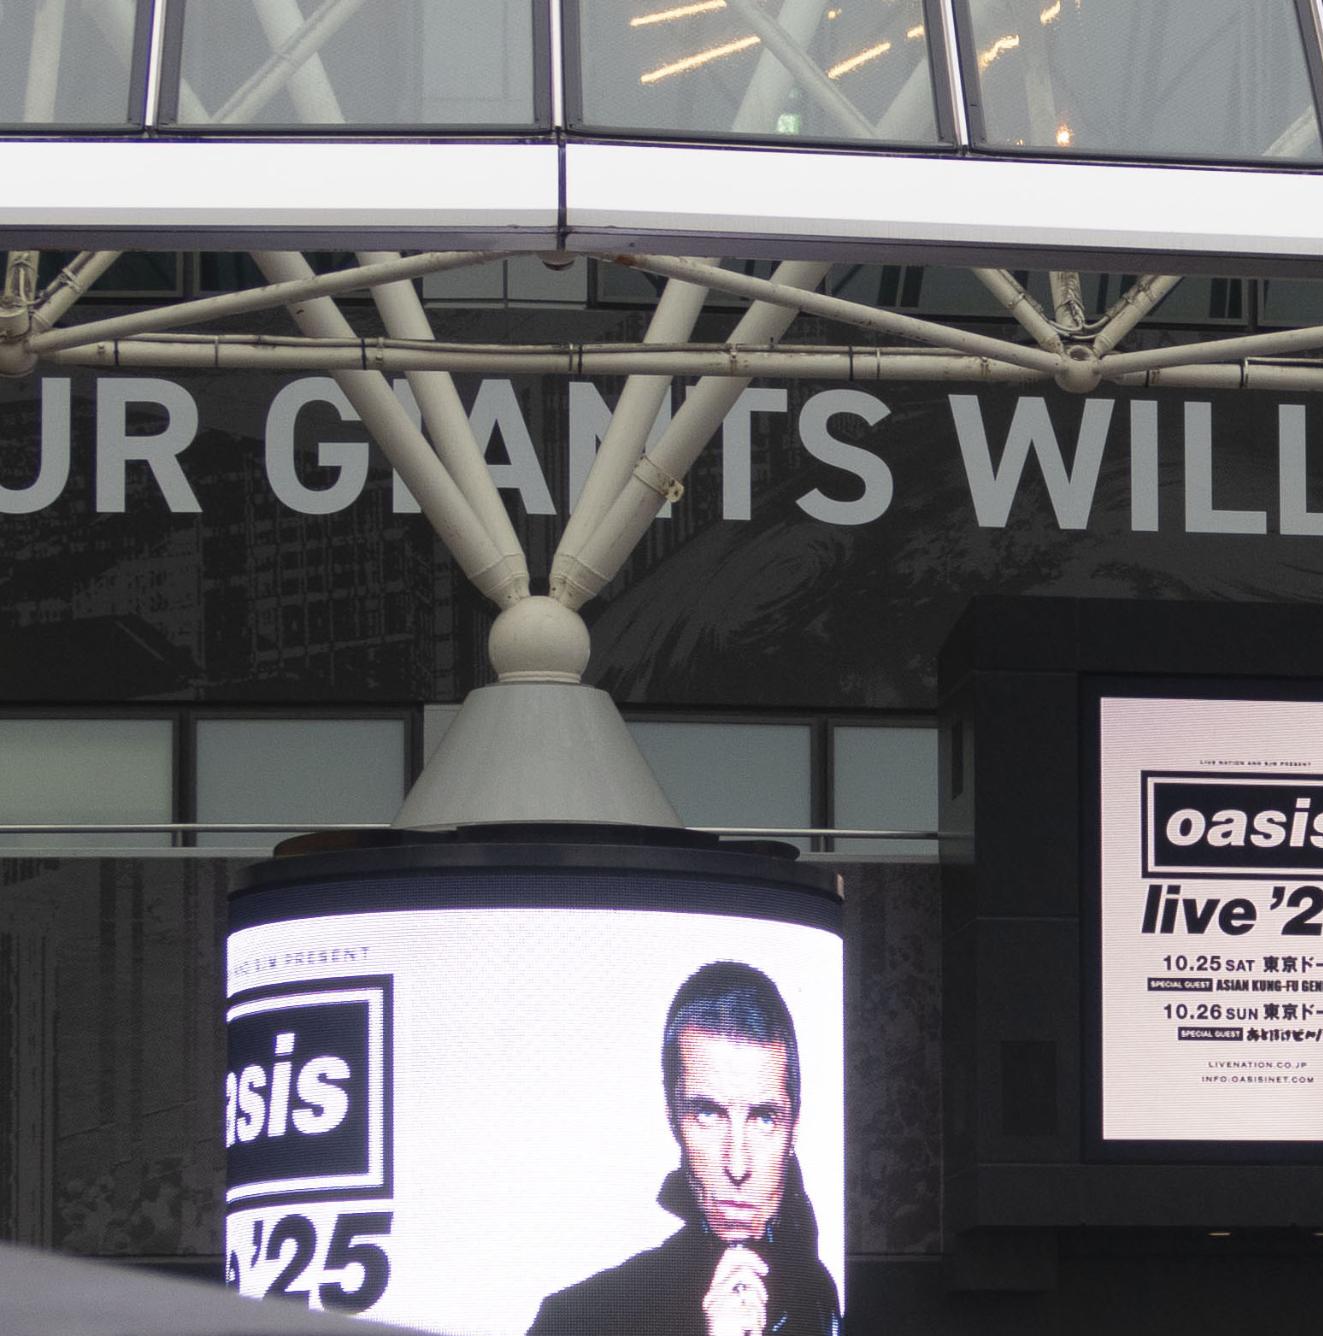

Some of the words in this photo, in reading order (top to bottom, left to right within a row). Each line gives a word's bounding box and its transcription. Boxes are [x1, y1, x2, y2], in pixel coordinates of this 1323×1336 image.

[1141, 884, 1258, 936] live
[1163, 955, 1222, 972] 10.25
[1225, 960, 1256, 972] SAT
[1216, 979, 1250, 992] ASIAN
[1252, 980, 1299, 992] KUNG-FU
[1163, 1004, 1222, 1020] 10.26
[1226, 1008, 1259, 1020] SUN
